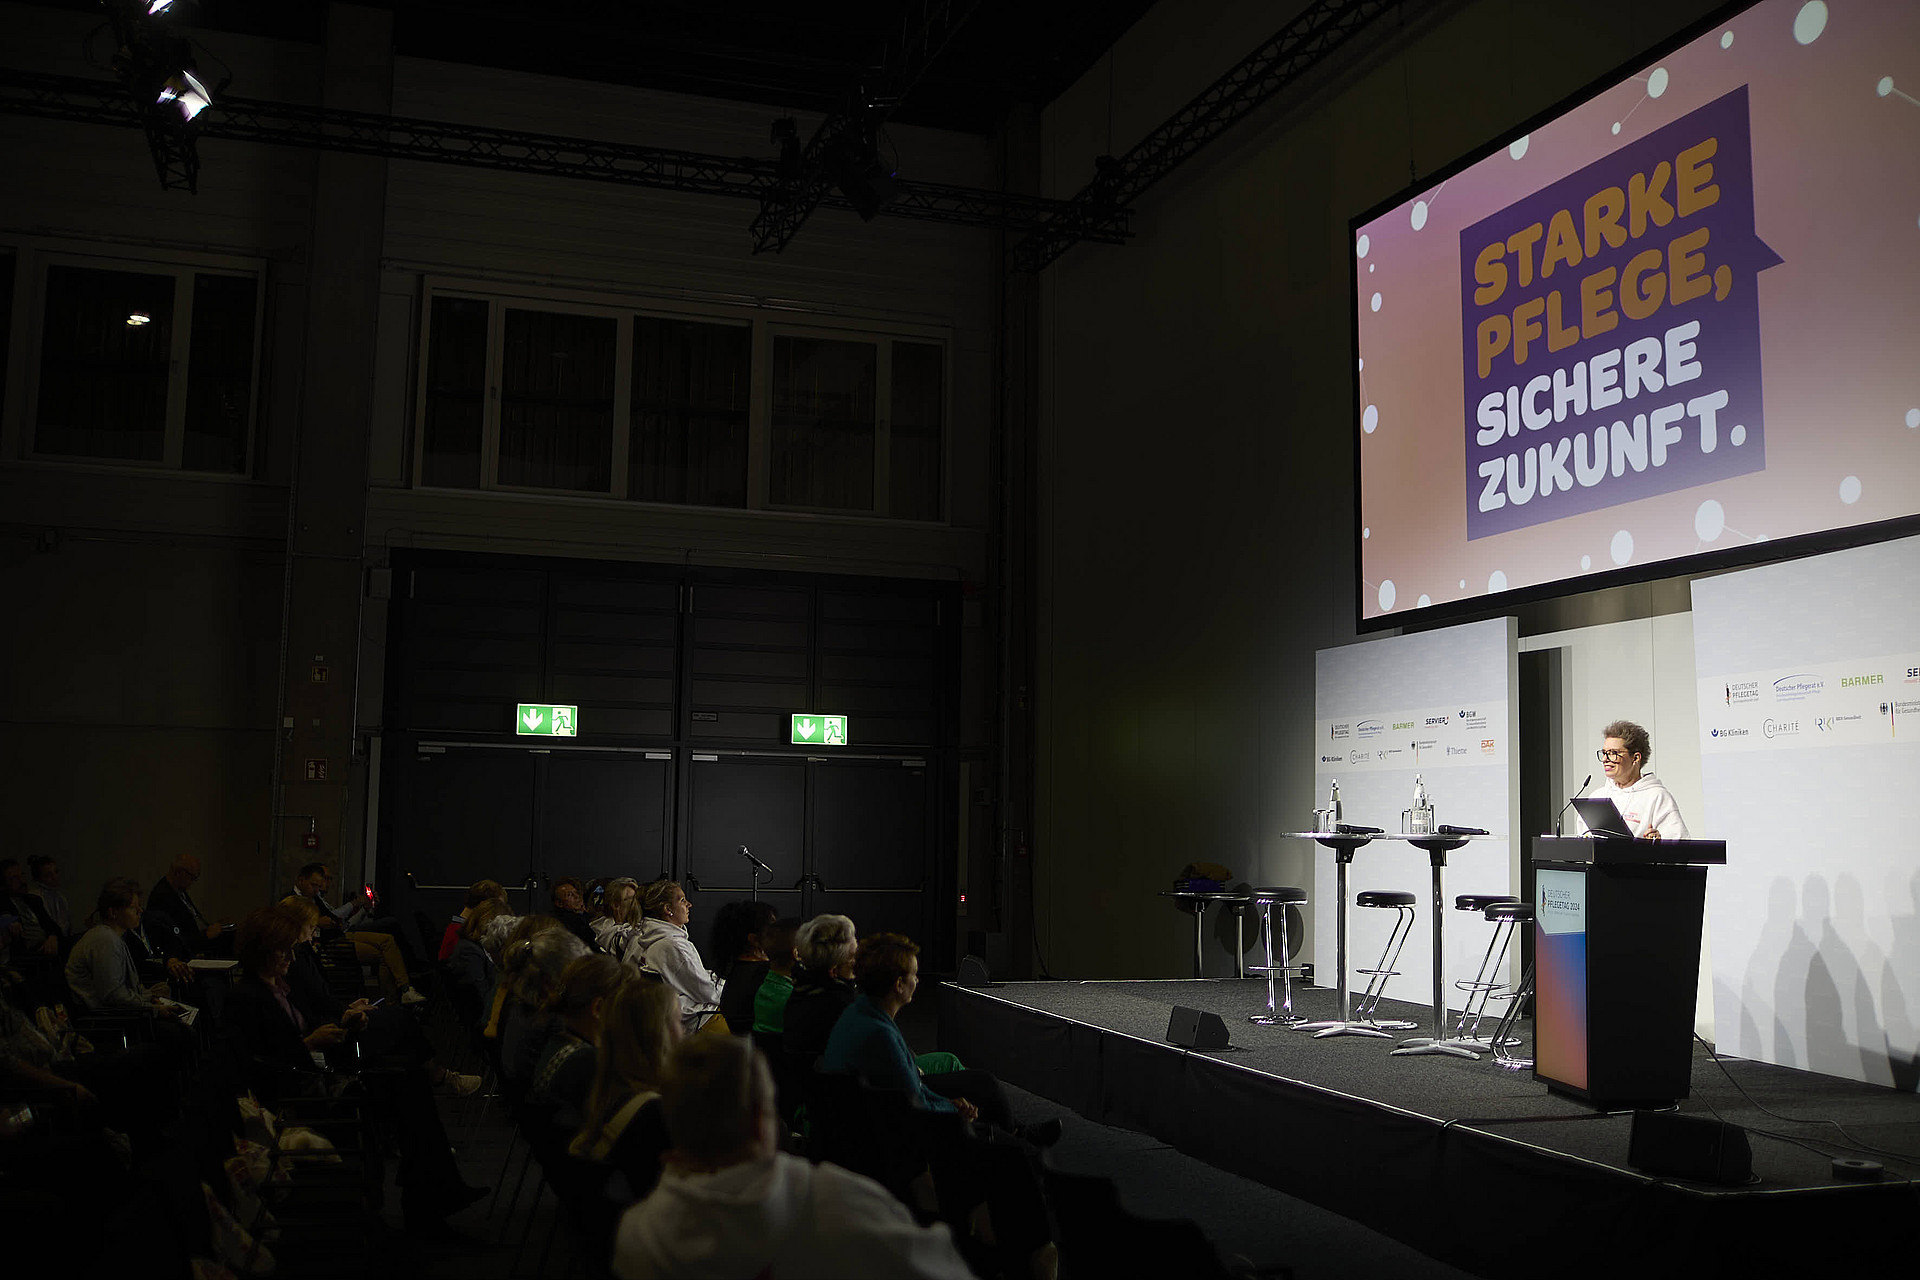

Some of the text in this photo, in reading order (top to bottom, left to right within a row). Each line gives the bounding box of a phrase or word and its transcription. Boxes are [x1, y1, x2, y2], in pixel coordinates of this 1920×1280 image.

[1474, 137, 1720, 305] STARKE
[1477, 227, 1732, 379] PFLEGE,
[1476, 320, 1702, 446] SICHERE
[1478, 389, 1747, 512] ZUKUNFT.
[1907, 668, 1920, 677] SE
[1732, 682, 1758, 691] DEUTSCHER
[1841, 674, 1884, 688] BARMER
[1732, 690, 1759, 699] PFLEGETAG
[1392, 722, 1414, 730] BARMER
[1425, 717, 1447, 725] SERVIER
[1767, 720, 1799, 733] CHARITÉ
[1728, 728, 1749, 736] Kliniken
